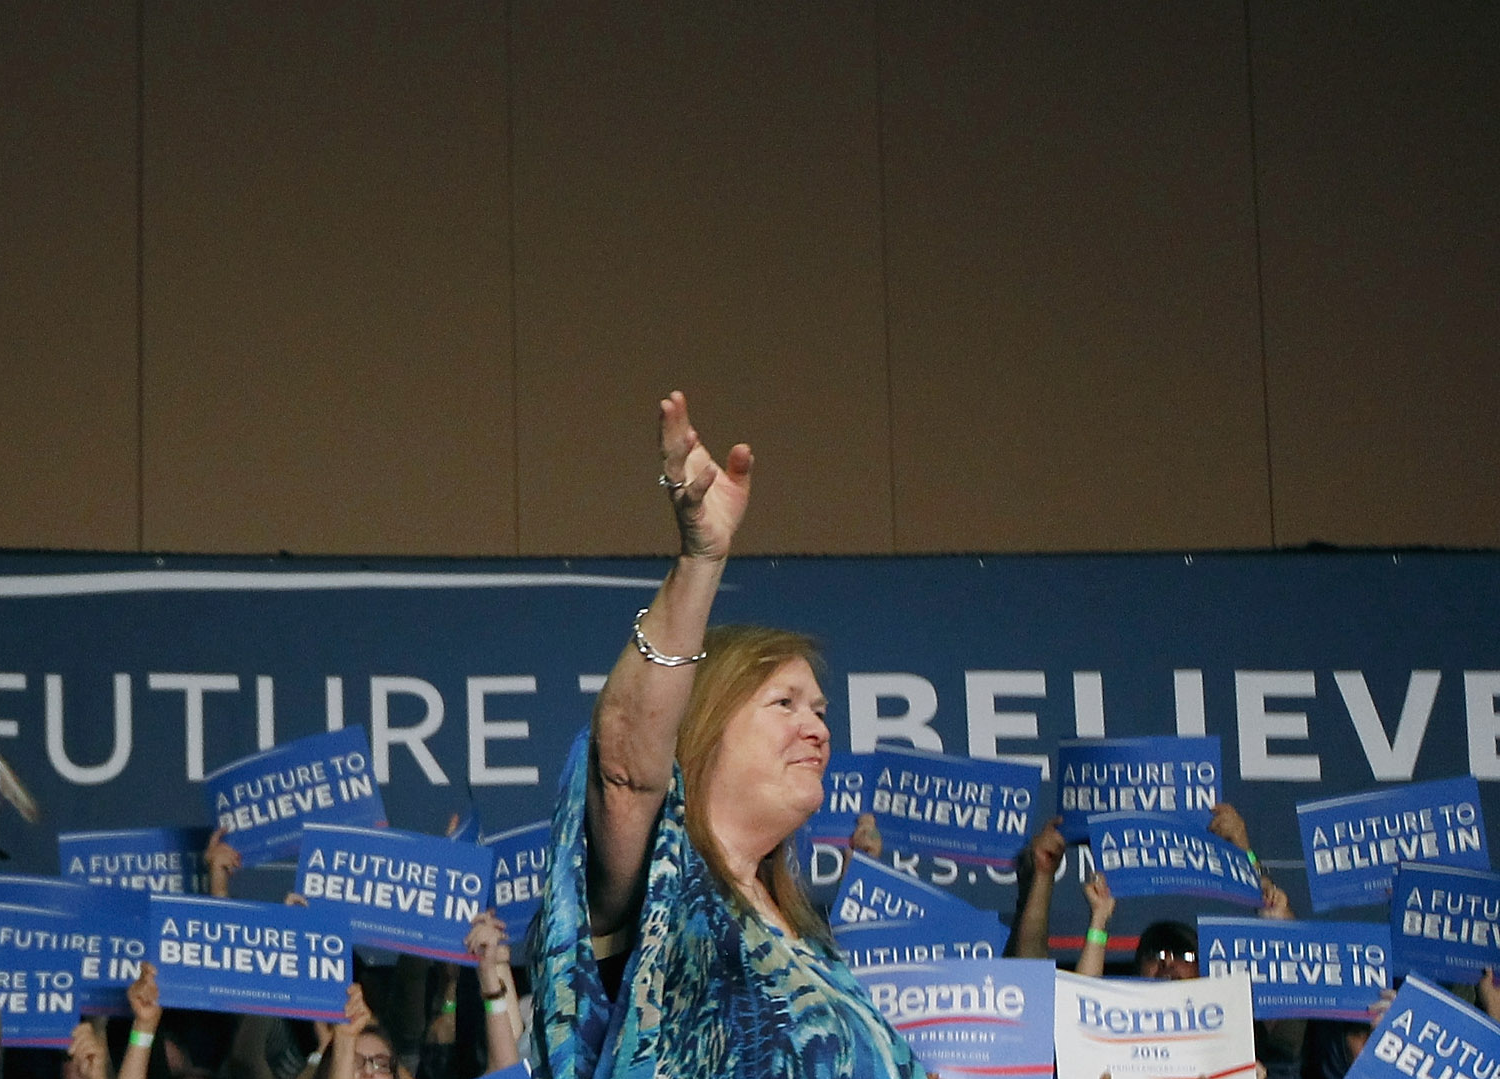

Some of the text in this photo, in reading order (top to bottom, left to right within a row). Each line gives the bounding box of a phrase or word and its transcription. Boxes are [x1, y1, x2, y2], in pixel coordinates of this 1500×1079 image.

[216, 752, 363, 811] A FUTURE TO
[830, 771, 863, 792] TO
[877, 767, 1031, 810] A FUTURE TO
[1064, 761, 1216, 786] A FUTURE TO
[218, 774, 372, 833] BELIEVE IN
[829, 790, 861, 814] IN
[872, 788, 1028, 836] BELIEVE IN
[1062, 785, 1216, 811] BELIEVE IN
[1313, 802, 1476, 849] A FUTURE TO
[1102, 831, 1118, 851] A
[1123, 829, 1217, 857] FUTURE
[1314, 825, 1481, 875] BELIEVE IN
[69, 856, 85, 875] A
[89, 852, 182, 874] FUTURE
[308, 848, 325, 869] A
[333, 850, 438, 889] FUTURE
[446, 867, 482, 895] TO
[495, 857, 510, 878] A
[1102, 846, 1224, 878] BELIEVE
[303, 872, 480, 922] BELIEVE IN
[848, 878, 864, 900] A
[869, 886, 925, 919] FUT
[1406, 887, 1500, 921] A FUTU
[0, 927, 146, 957] FUTURE TO
[161, 918, 345, 956] A FUTURE TO
[1402, 909, 1500, 950] BELIE
[159, 940, 347, 982] BELIEVE IN
[962, 940, 993, 960] TO
[1209, 938, 1386, 966] A FUTURE TO
[35, 971, 74, 989] TO
[108, 958, 143, 981] IN
[1208, 960, 1387, 990] BELIEVE IN
[37, 992, 74, 1013] IN
[868, 975, 1025, 1018] Bernie
[1076, 994, 1224, 1035] Bernie
[1392, 1008, 1414, 1036] A
[921, 1030, 996, 1043] PRESIDENT
[1130, 1046, 1171, 1060] 2016
